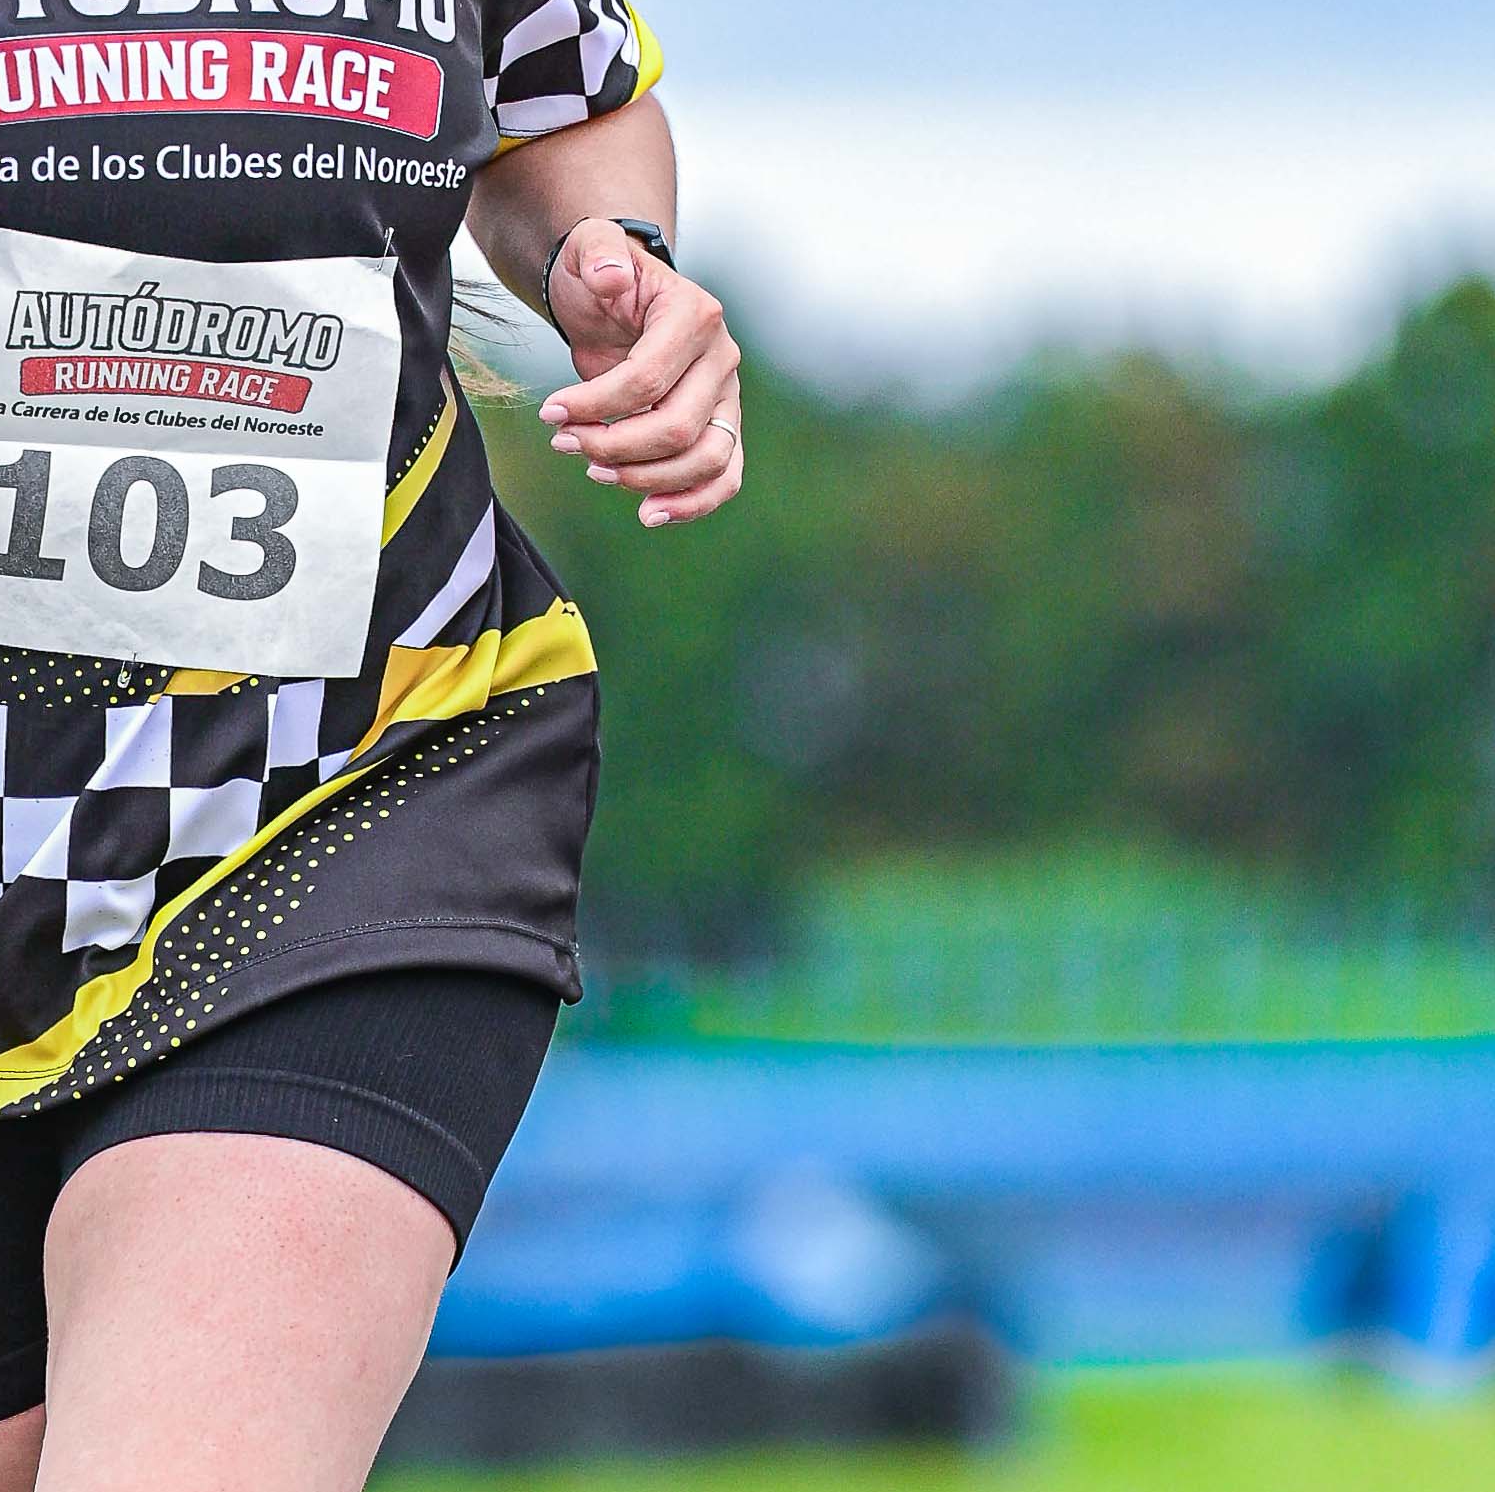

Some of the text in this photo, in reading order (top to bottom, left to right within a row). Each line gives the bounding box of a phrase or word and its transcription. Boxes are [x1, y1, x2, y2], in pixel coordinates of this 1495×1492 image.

[249, 40, 396, 119] RACE
[31, 145, 80, 182] de
[92, 144, 145, 181] los
[156, 142, 283, 180] Clubes
[292, 143, 345, 179] del
[354, 145, 467, 189] Noroeste
[6, 281, 344, 371] AUTÓDROMO
[54, 361, 279, 406] RUNNING RACE
[11, 400, 80, 420] Carrera
[84, 405, 109, 422] de
[112, 406, 141, 425] los
[144, 409, 207, 428] Clubes
[210, 414, 241, 431] del
[243, 416, 324, 437] Noroeste
